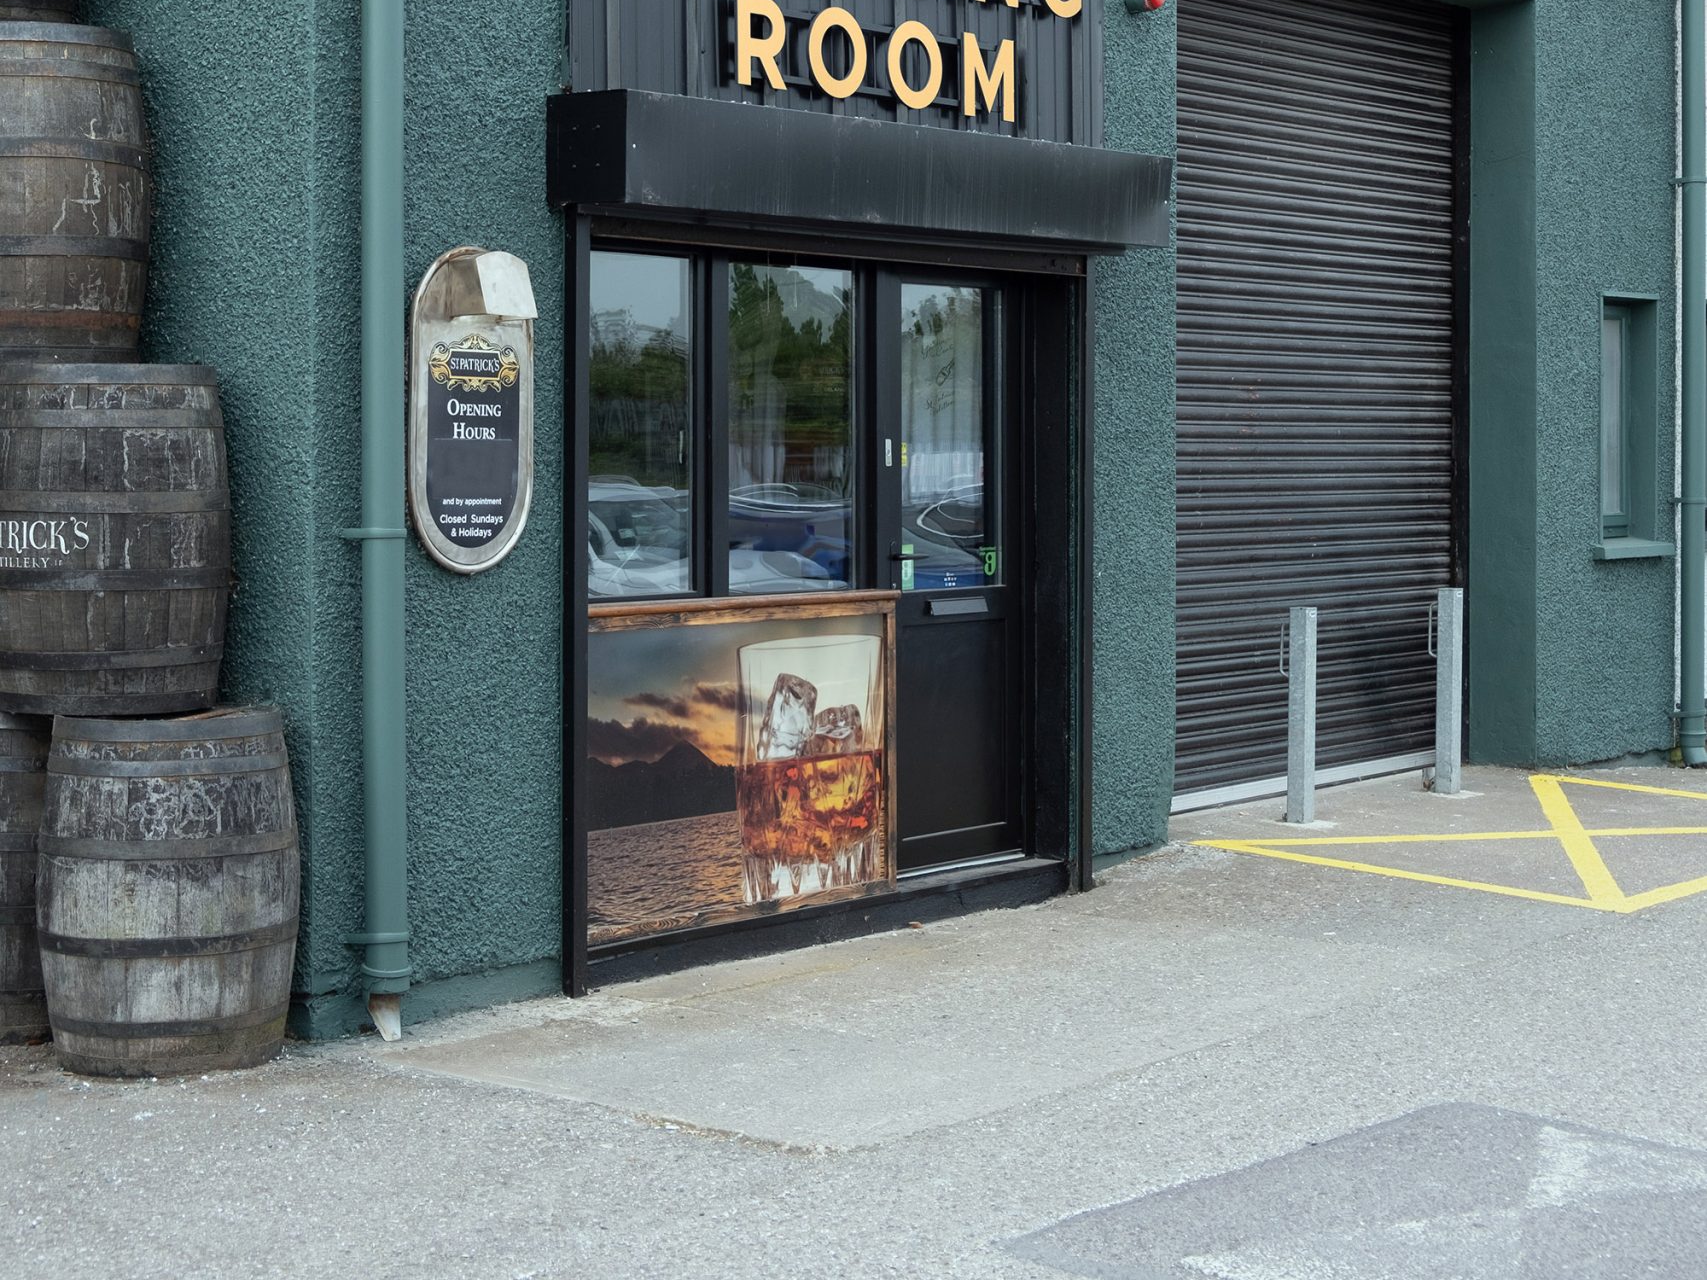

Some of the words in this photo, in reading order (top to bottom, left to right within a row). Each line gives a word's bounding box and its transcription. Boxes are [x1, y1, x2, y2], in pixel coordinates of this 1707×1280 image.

[447, 398, 502, 417] OPENING
[452, 421, 496, 440] HOURS
[442, 497, 454, 505] and
[455, 497, 464, 507] by
[464, 497, 502, 507] appointment
[440, 513, 467, 524] Closed
[470, 513, 504, 525] Sundays
[450, 527, 457, 537] &
[458, 526, 492, 538] Holidays
